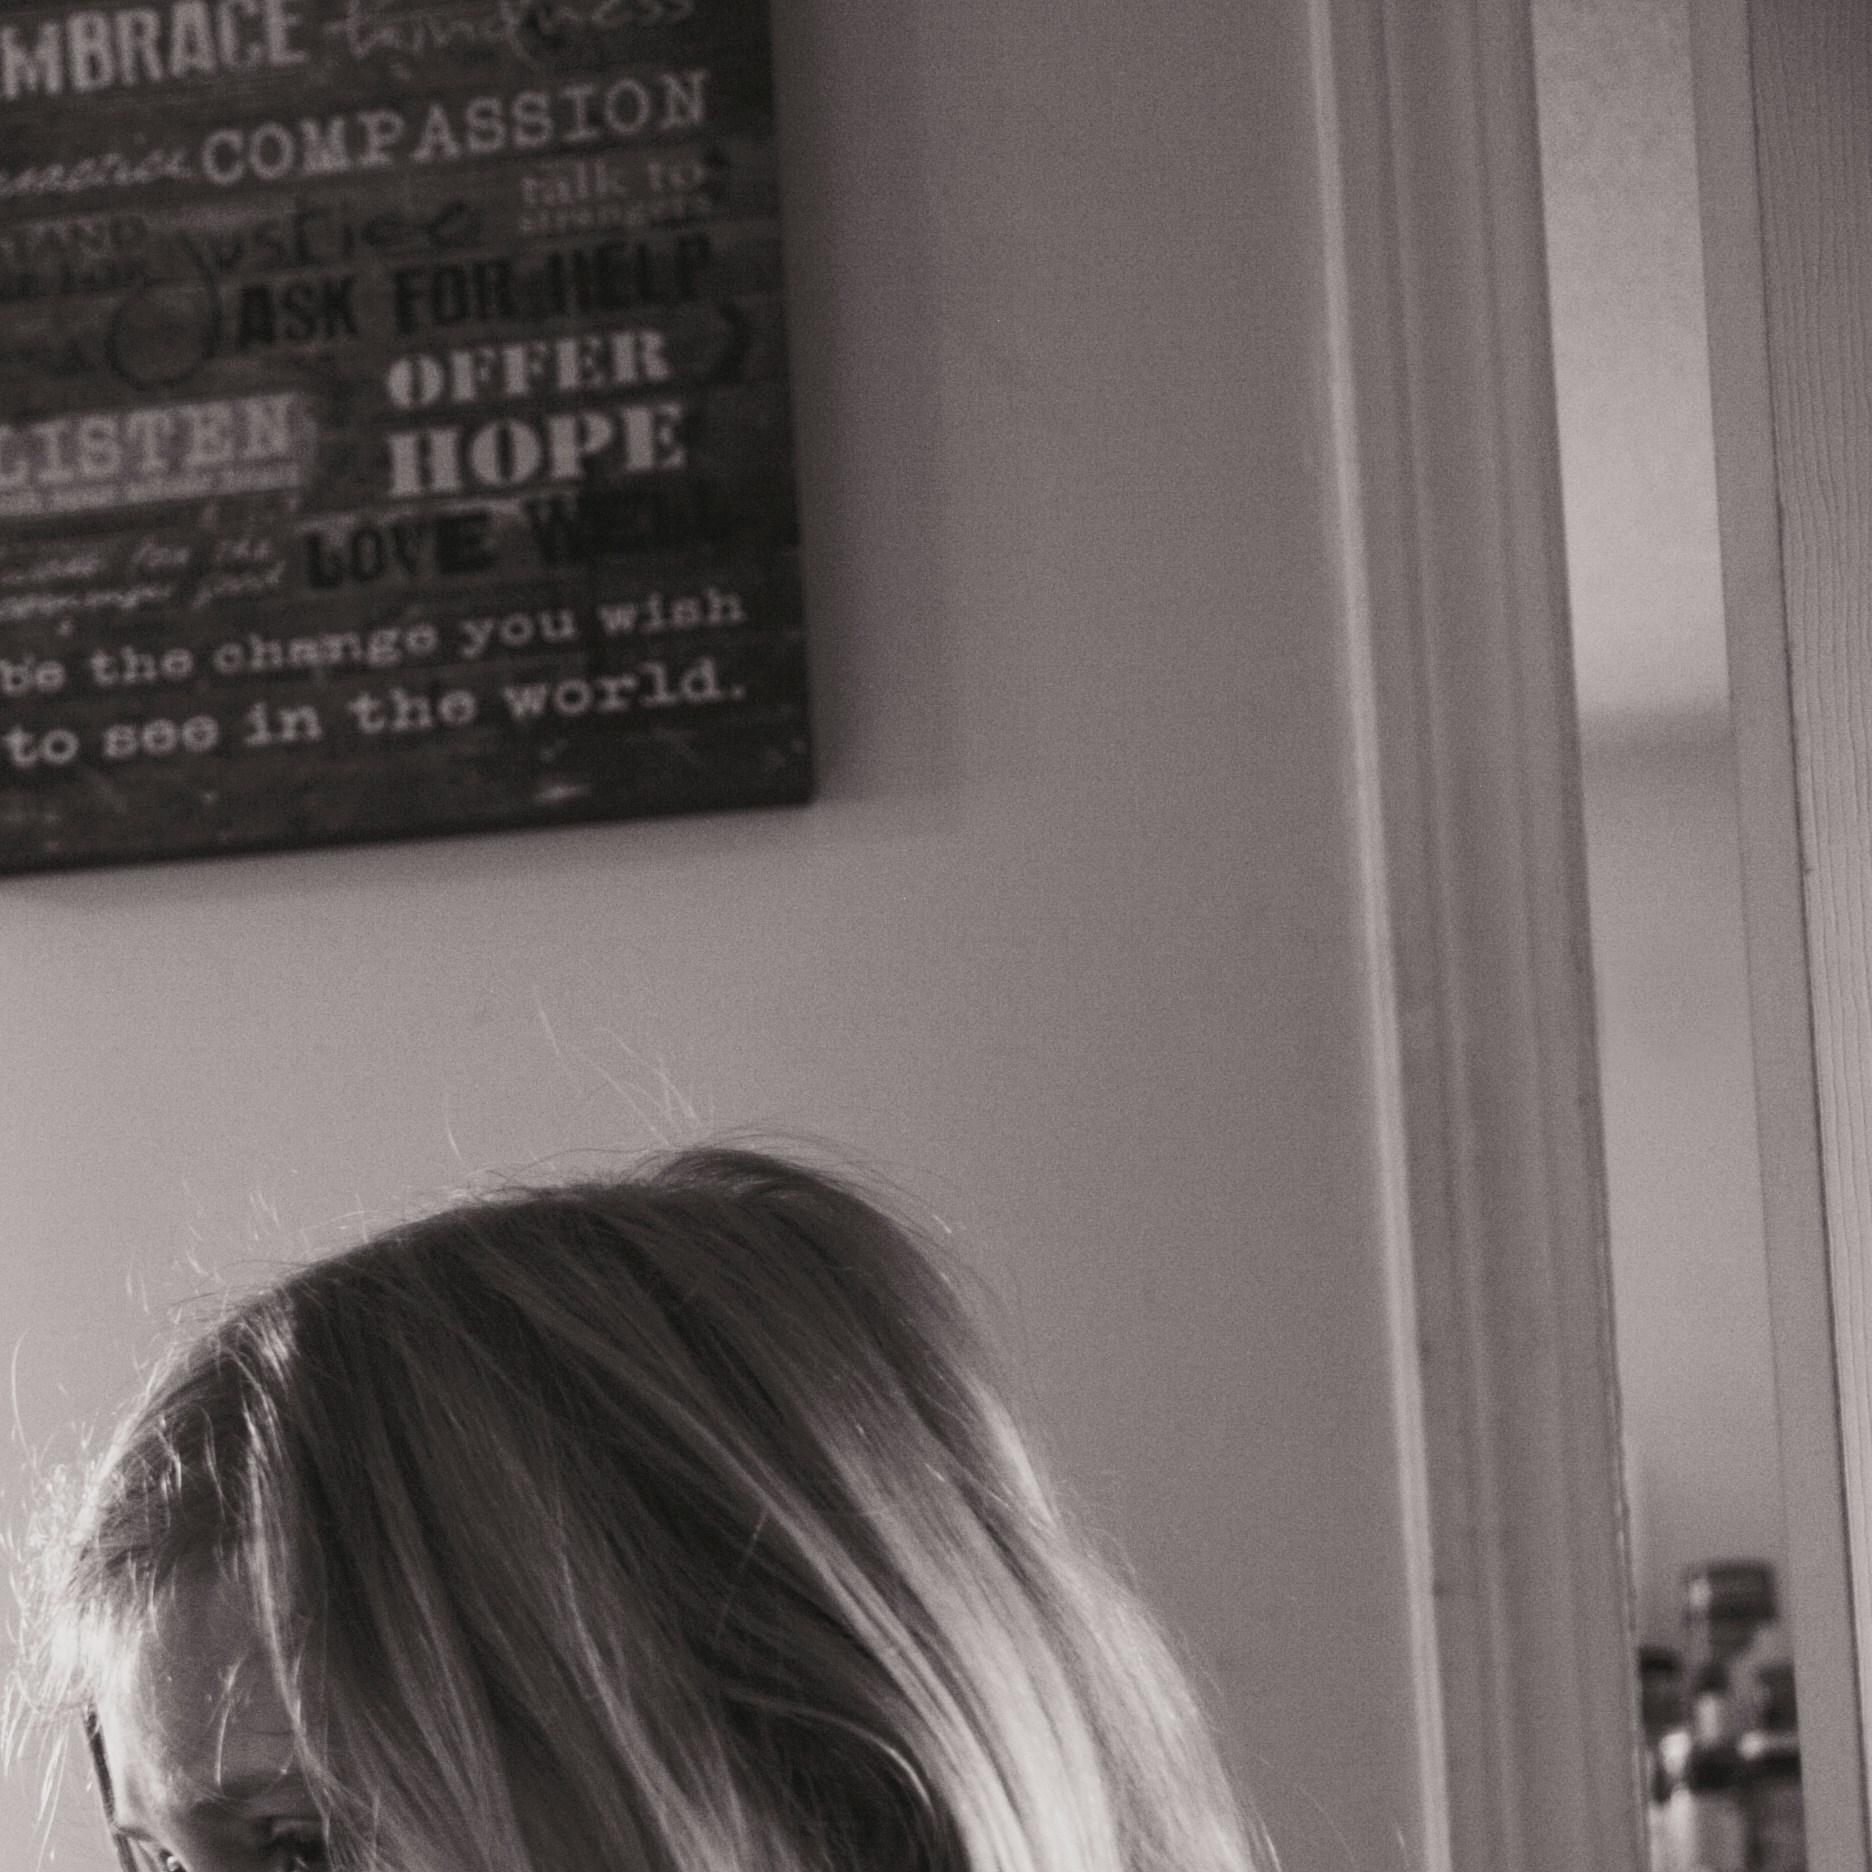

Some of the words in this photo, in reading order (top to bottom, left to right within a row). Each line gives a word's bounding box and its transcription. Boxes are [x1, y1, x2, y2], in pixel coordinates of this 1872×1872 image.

[201, 71, 709, 186] COMPASSION
[520, 156, 628, 208] talk
[236, 275, 357, 352] ASK
[394, 257, 514, 334] FOR
[546, 234, 712, 315] HELP
[386, 328, 672, 410] OFFER
[387, 401, 686, 497] HOPE
[303, 509, 495, 591] LOVE
[85, 644, 195, 690] the
[212, 620, 438, 674] change
[458, 611, 578, 659] you
[598, 585, 745, 637] wish
[0, 722, 80, 769] to
[100, 712, 219, 761] see
[242, 700, 324, 751] in
[346, 686, 479, 735] the
[499, 657, 750, 720] world.
